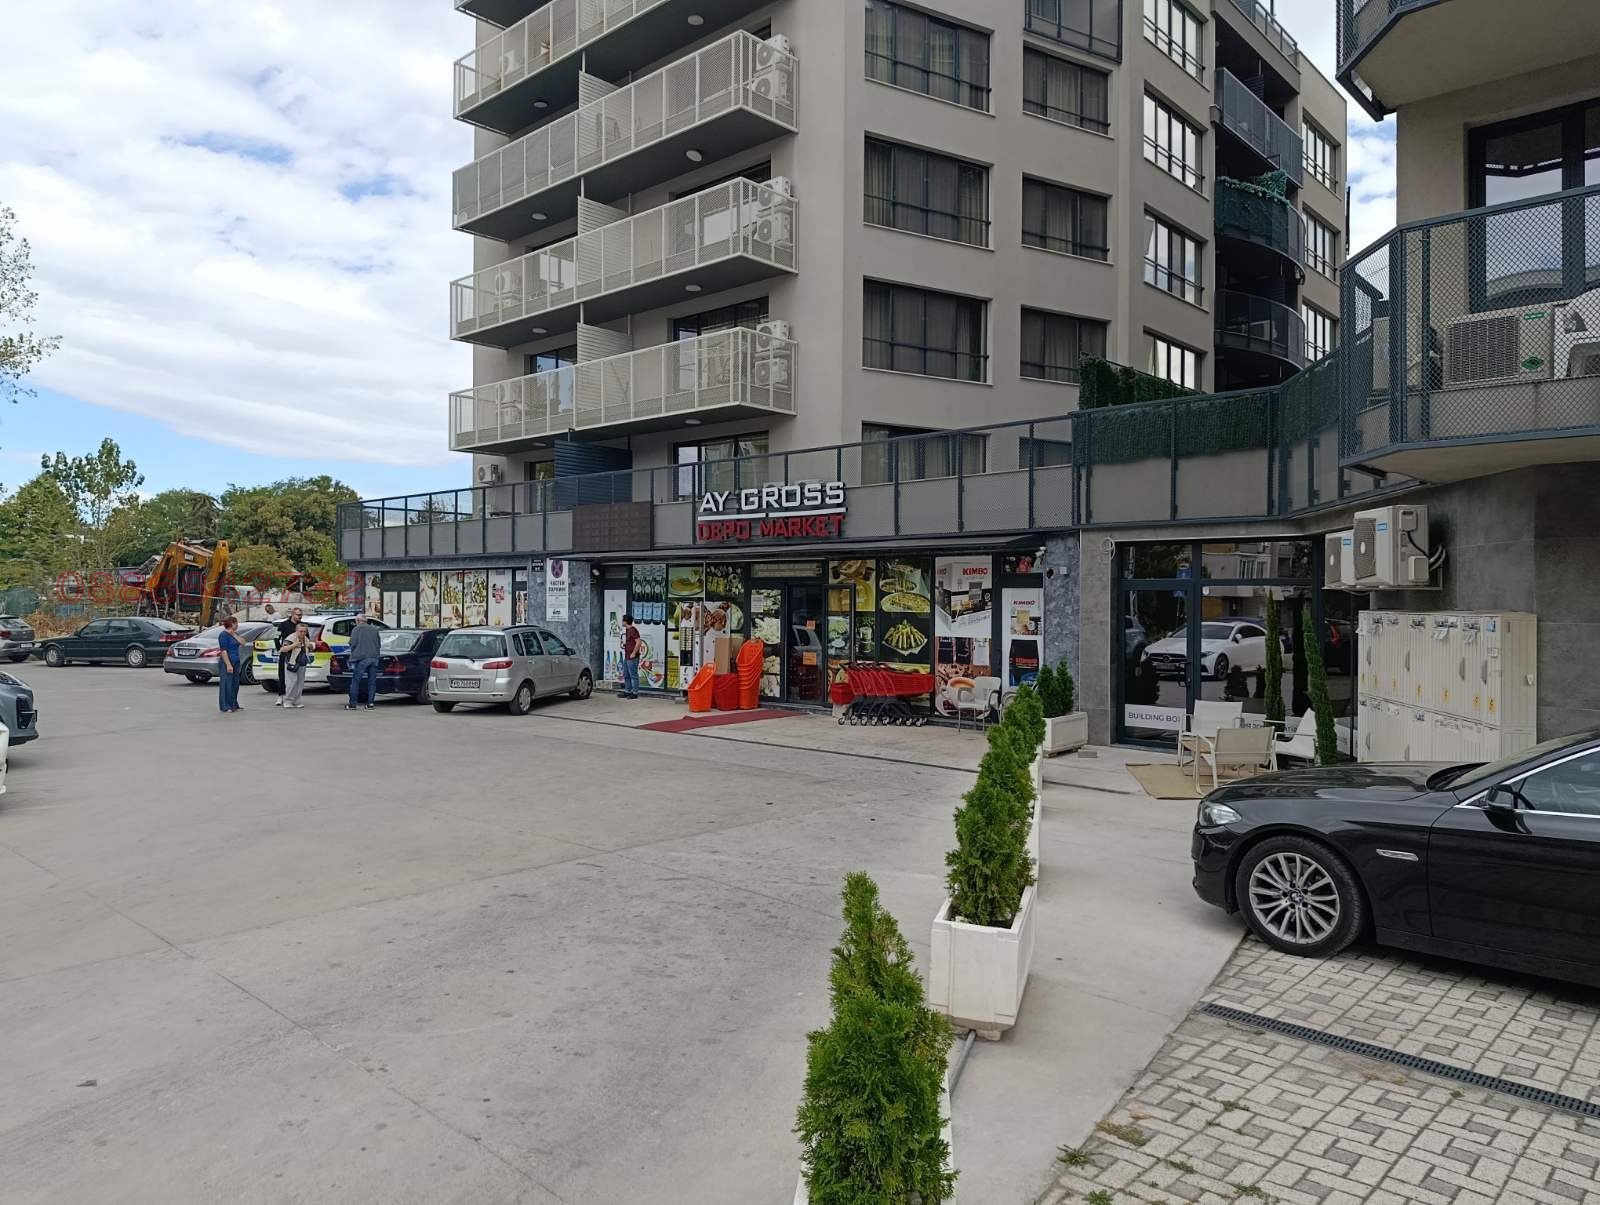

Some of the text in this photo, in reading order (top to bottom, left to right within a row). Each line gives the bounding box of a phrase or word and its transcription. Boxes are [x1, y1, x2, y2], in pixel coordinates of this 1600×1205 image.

[699, 481, 845, 513] AY GROSS
[697, 514, 844, 542] DEPO MARKET
[962, 567, 988, 576] KIMBO
[1128, 711, 1165, 722] BUILDING
